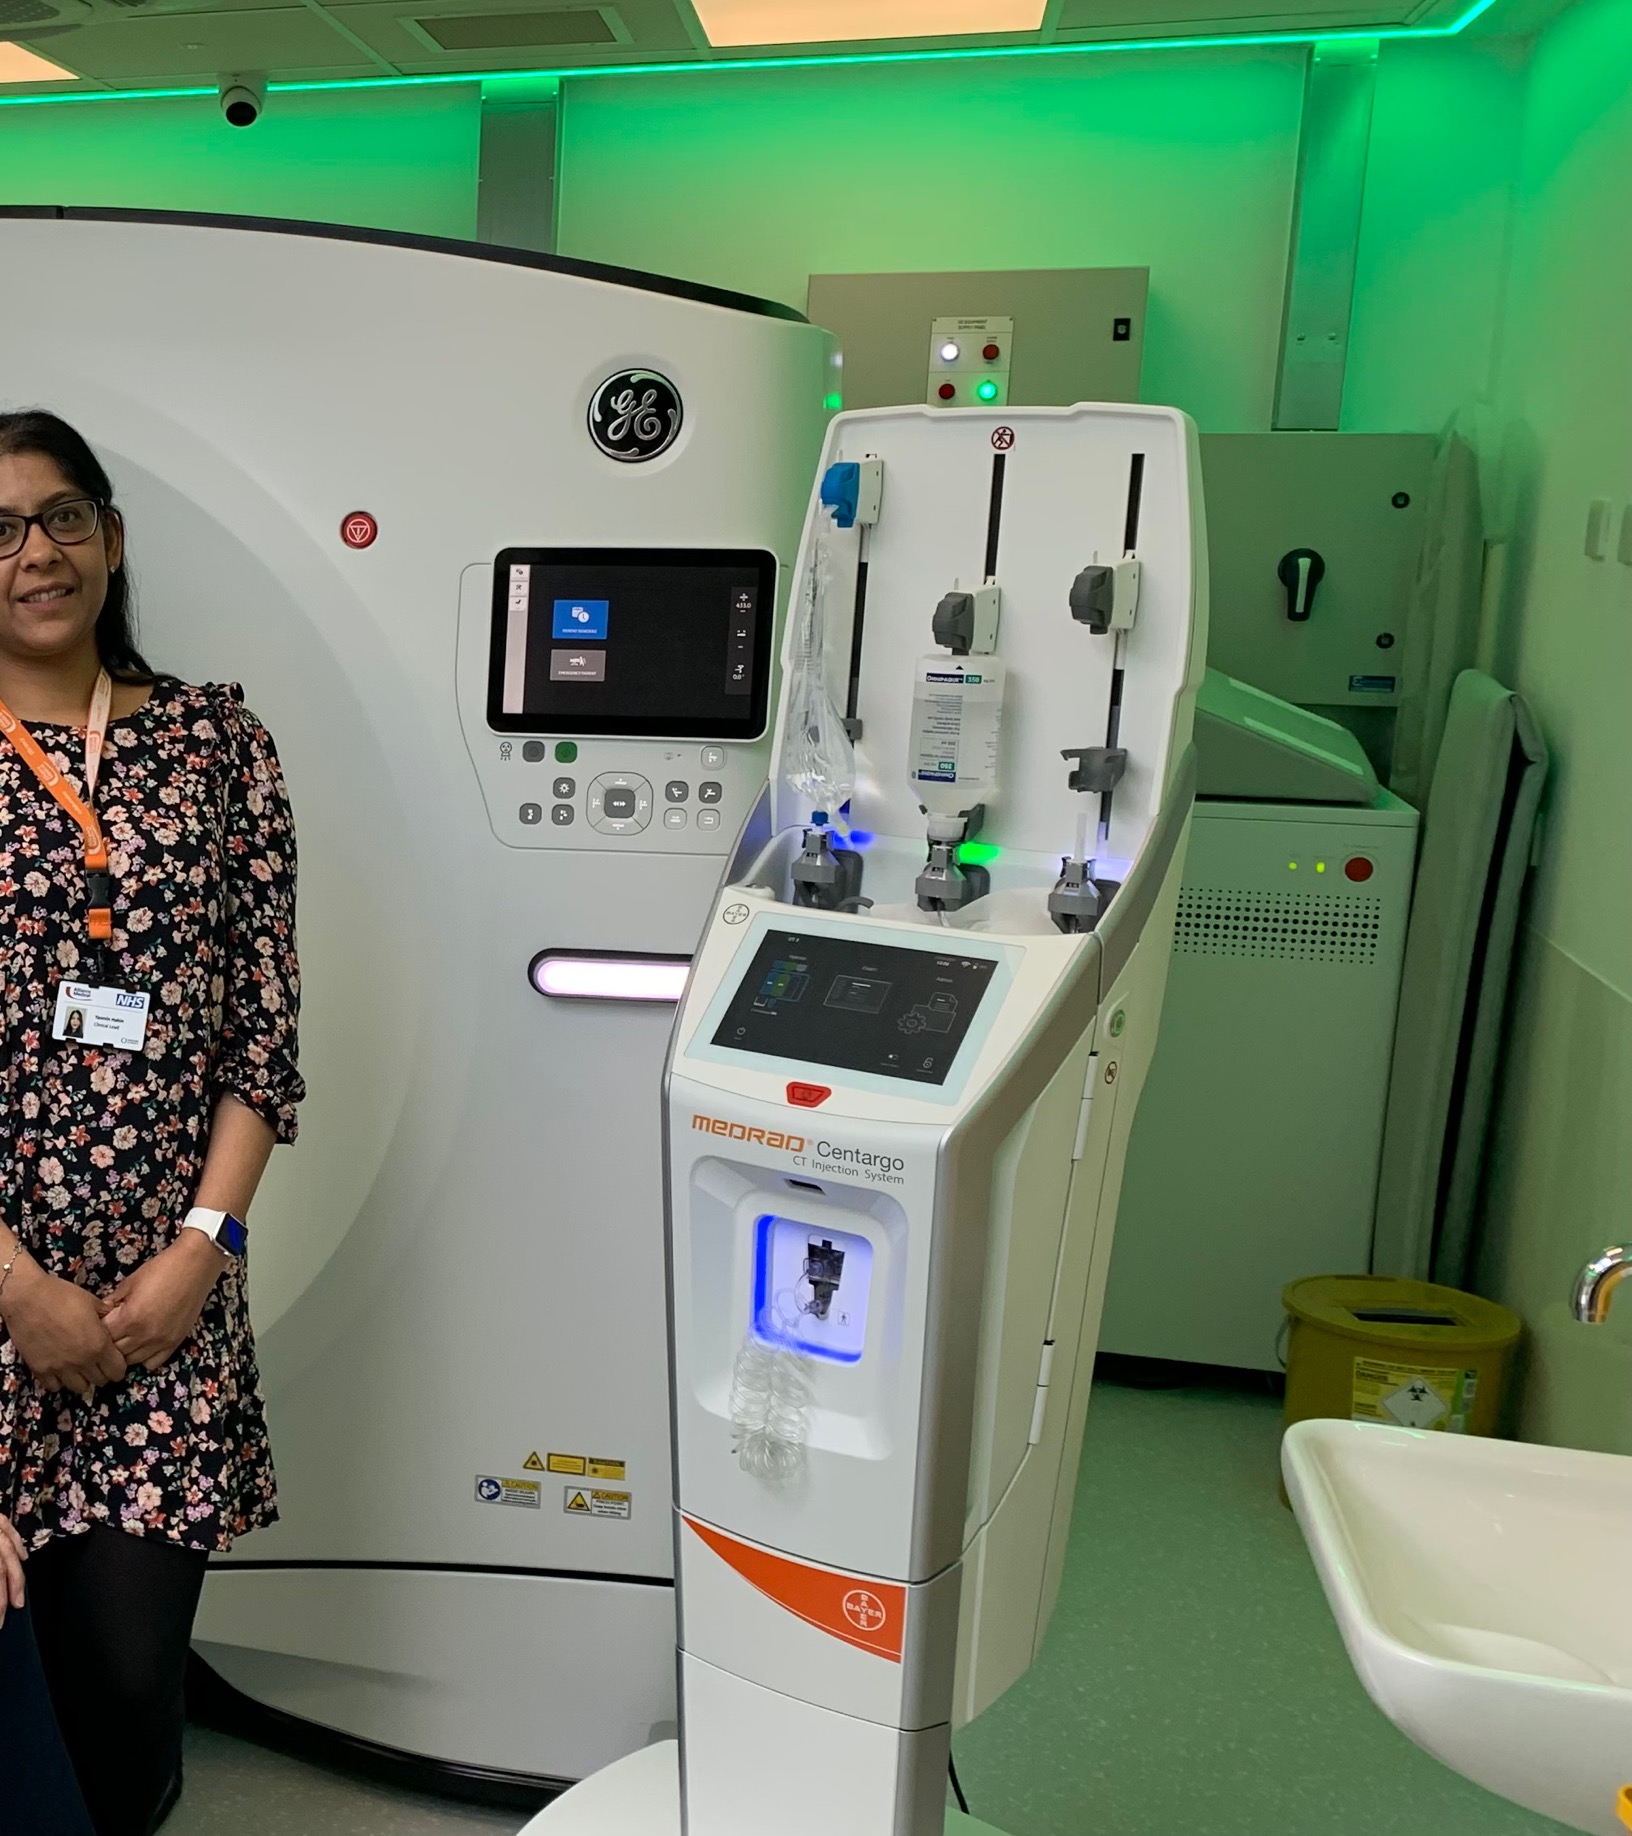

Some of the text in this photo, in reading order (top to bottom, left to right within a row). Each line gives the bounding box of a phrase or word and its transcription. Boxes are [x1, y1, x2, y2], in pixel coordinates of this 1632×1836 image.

[117, 994, 144, 1008] NHS
[816, 1140, 904, 1173] Centargo
[793, 1155, 904, 1184] CT Injection System
[600, 1491, 628, 1501] CAUTION
[846, 1601, 882, 1619] BAYER
